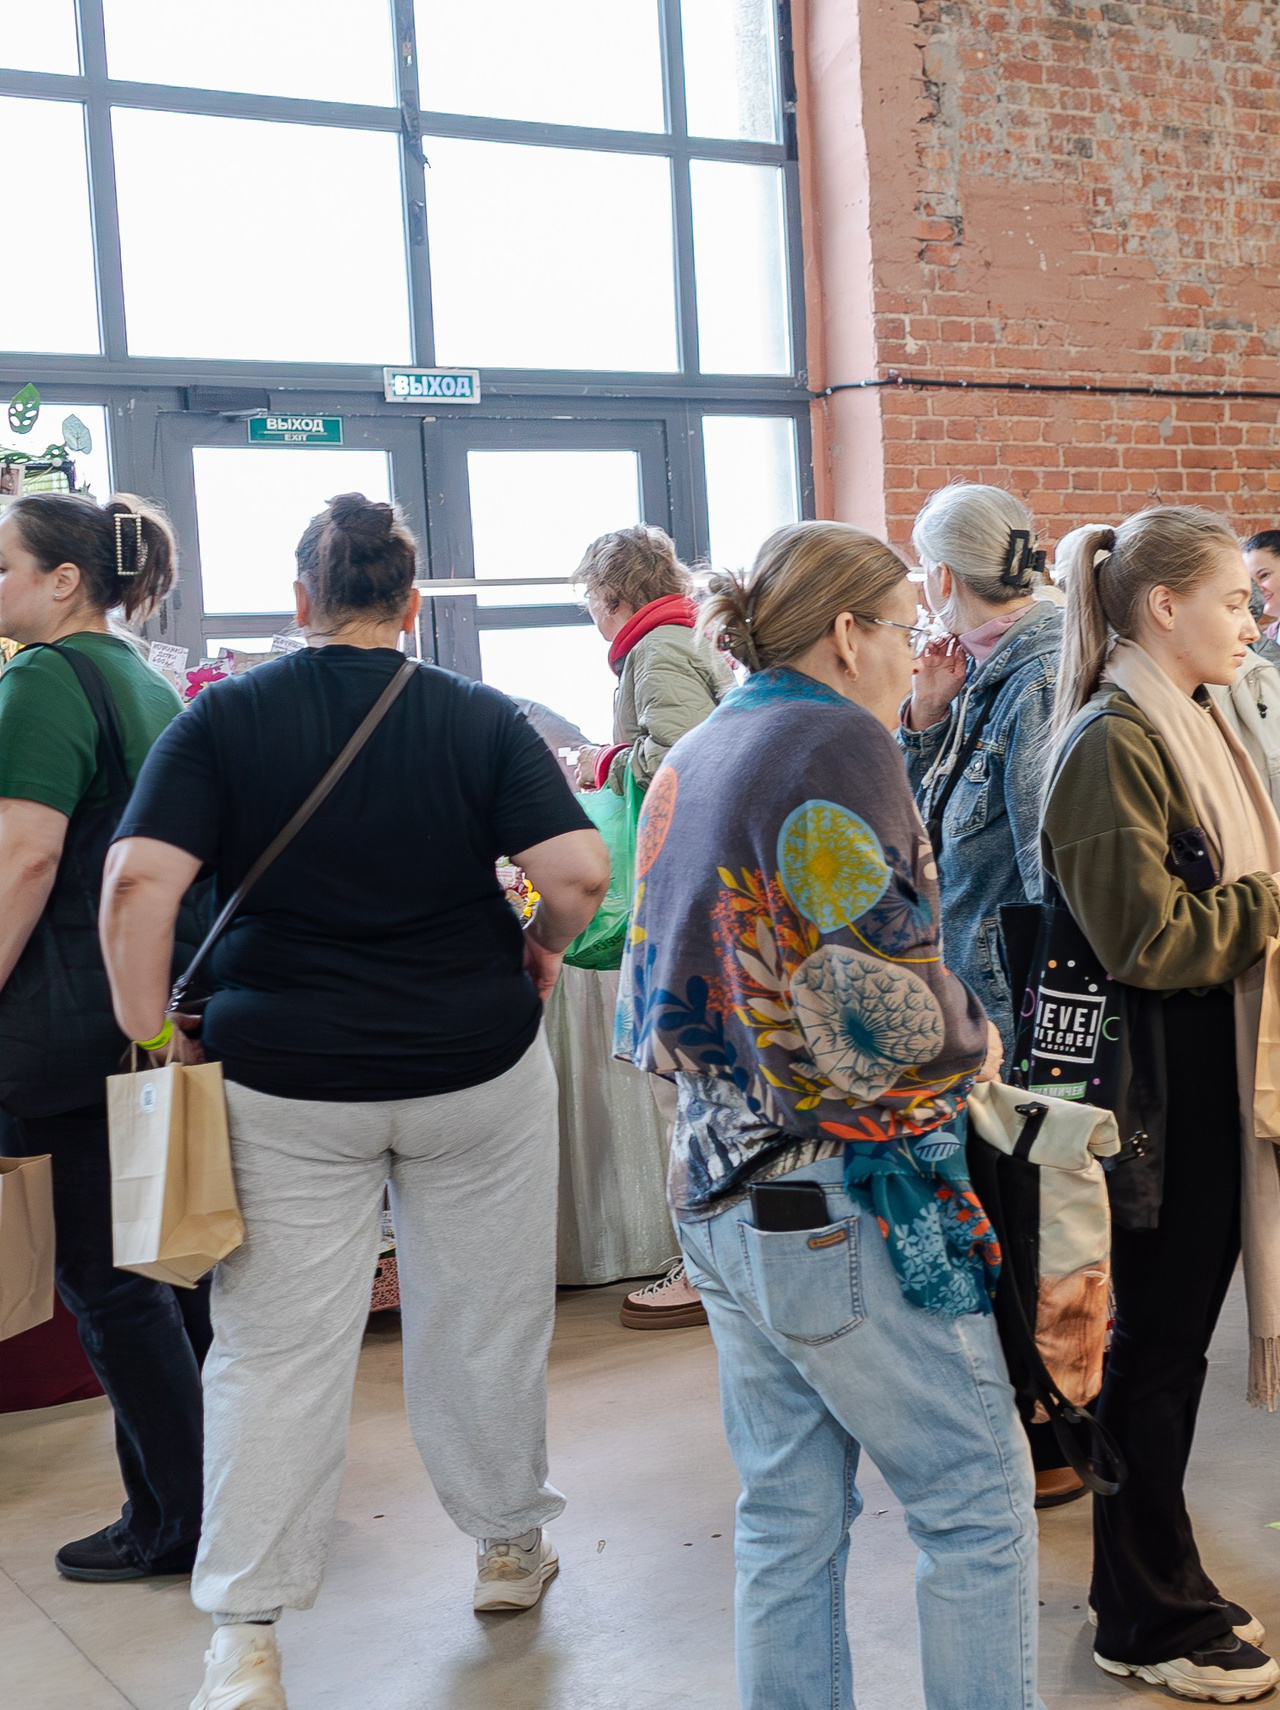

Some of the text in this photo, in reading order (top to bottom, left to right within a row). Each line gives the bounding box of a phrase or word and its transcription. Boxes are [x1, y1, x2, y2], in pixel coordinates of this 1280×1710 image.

[393, 374, 472, 397] ВЫХОД
[266, 417, 325, 433] ВЫХОД
[284, 433, 309, 442] EXIT
[1040, 1042, 1075, 1052] RUSSIA
